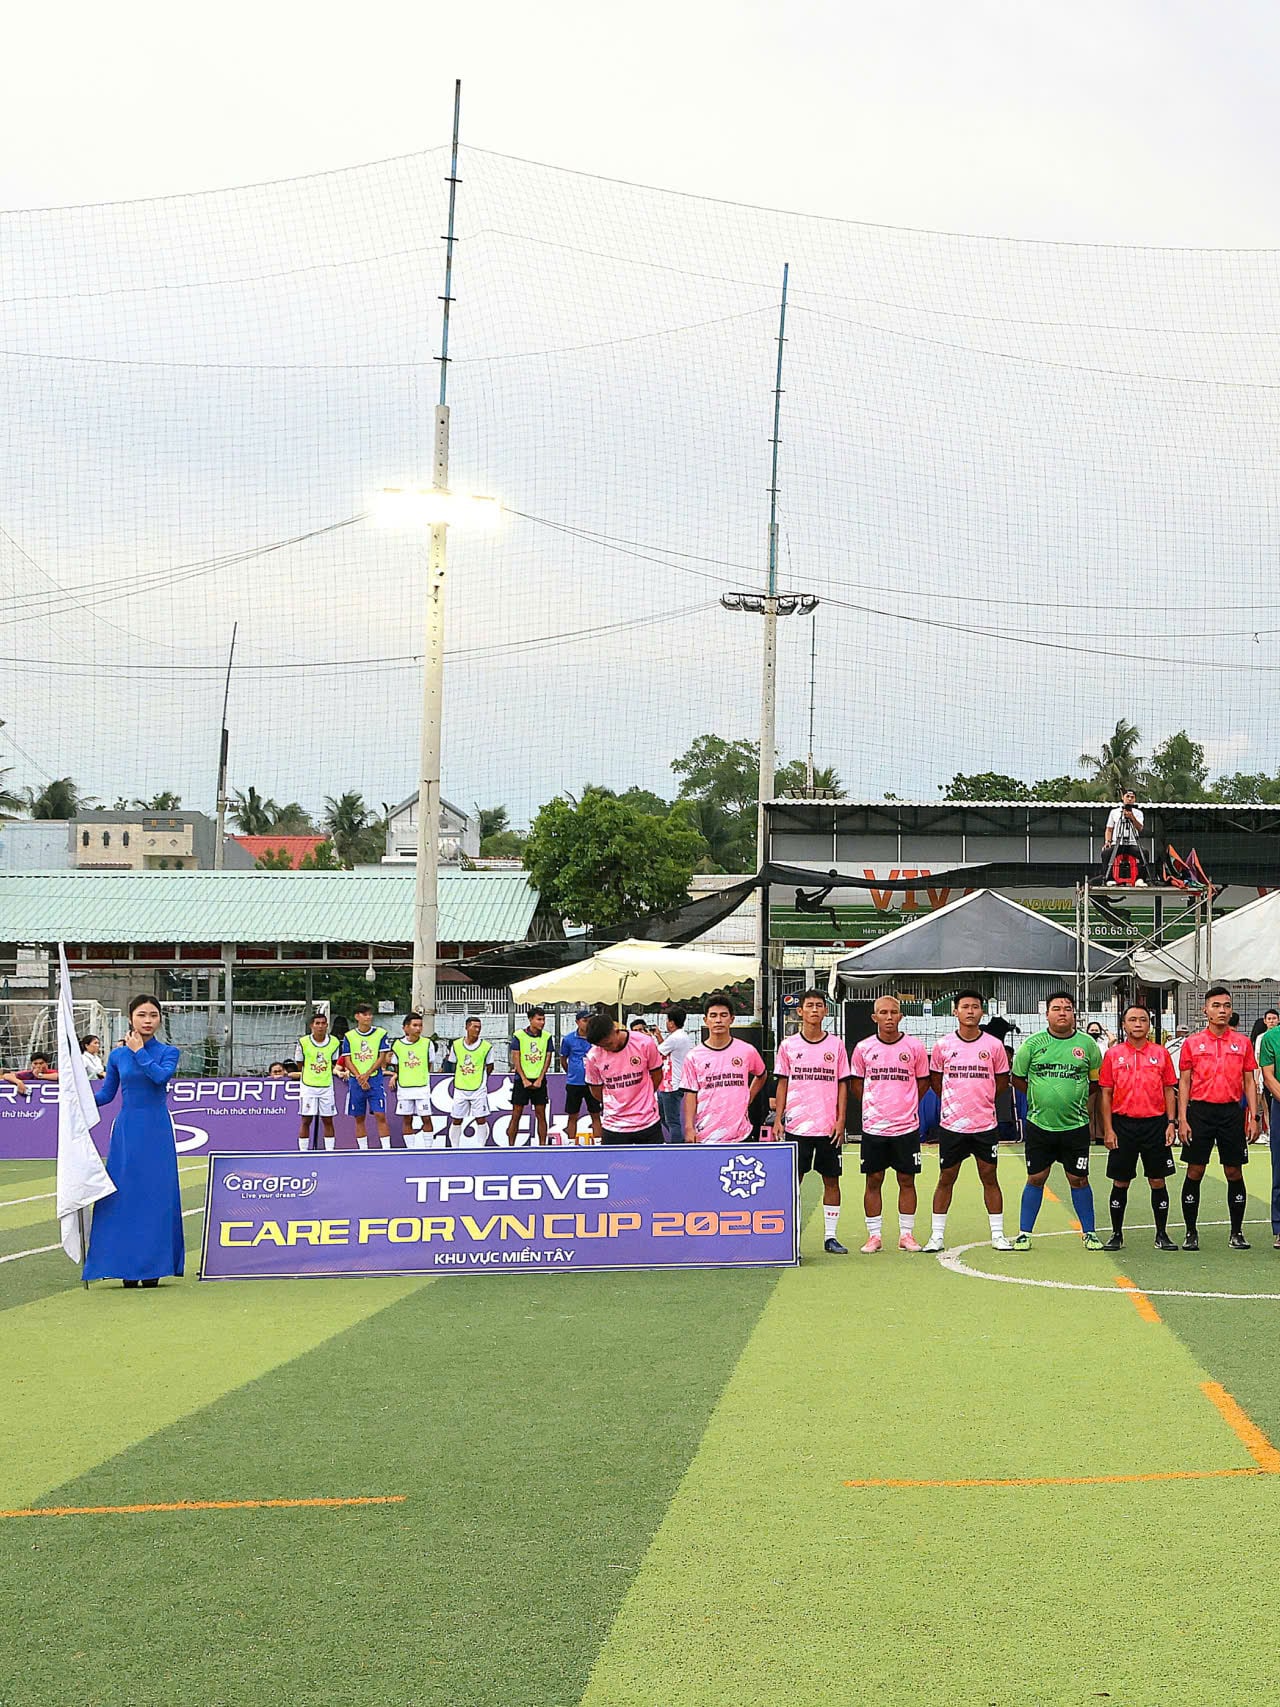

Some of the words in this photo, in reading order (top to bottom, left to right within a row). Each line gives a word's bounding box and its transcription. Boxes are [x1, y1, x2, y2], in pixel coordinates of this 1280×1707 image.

[524, 1053, 543, 1064] Tiger
[310, 1062, 328, 1073] Tiger
[206, 1107, 229, 1115] Thách
[230, 1107, 247, 1115] thức
[248, 1106, 263, 1115] thử
[264, 1107, 287, 1115] thách!
[730, 1170, 756, 1181] TPG
[224, 1174, 313, 1194] CareFor
[405, 1173, 610, 1203] TPG6V6
[219, 1218, 350, 1247] CARE
[358, 1216, 456, 1244] FOR
[459, 1213, 536, 1241] VN
[542, 1212, 643, 1240] CUP
[652, 1209, 785, 1237] 2026
[434, 1252, 467, 1265] KHU
[468, 1251, 500, 1266] VỰC
[502, 1246, 542, 1263] MIỀN
[543, 1248, 575, 1262] TÂY
